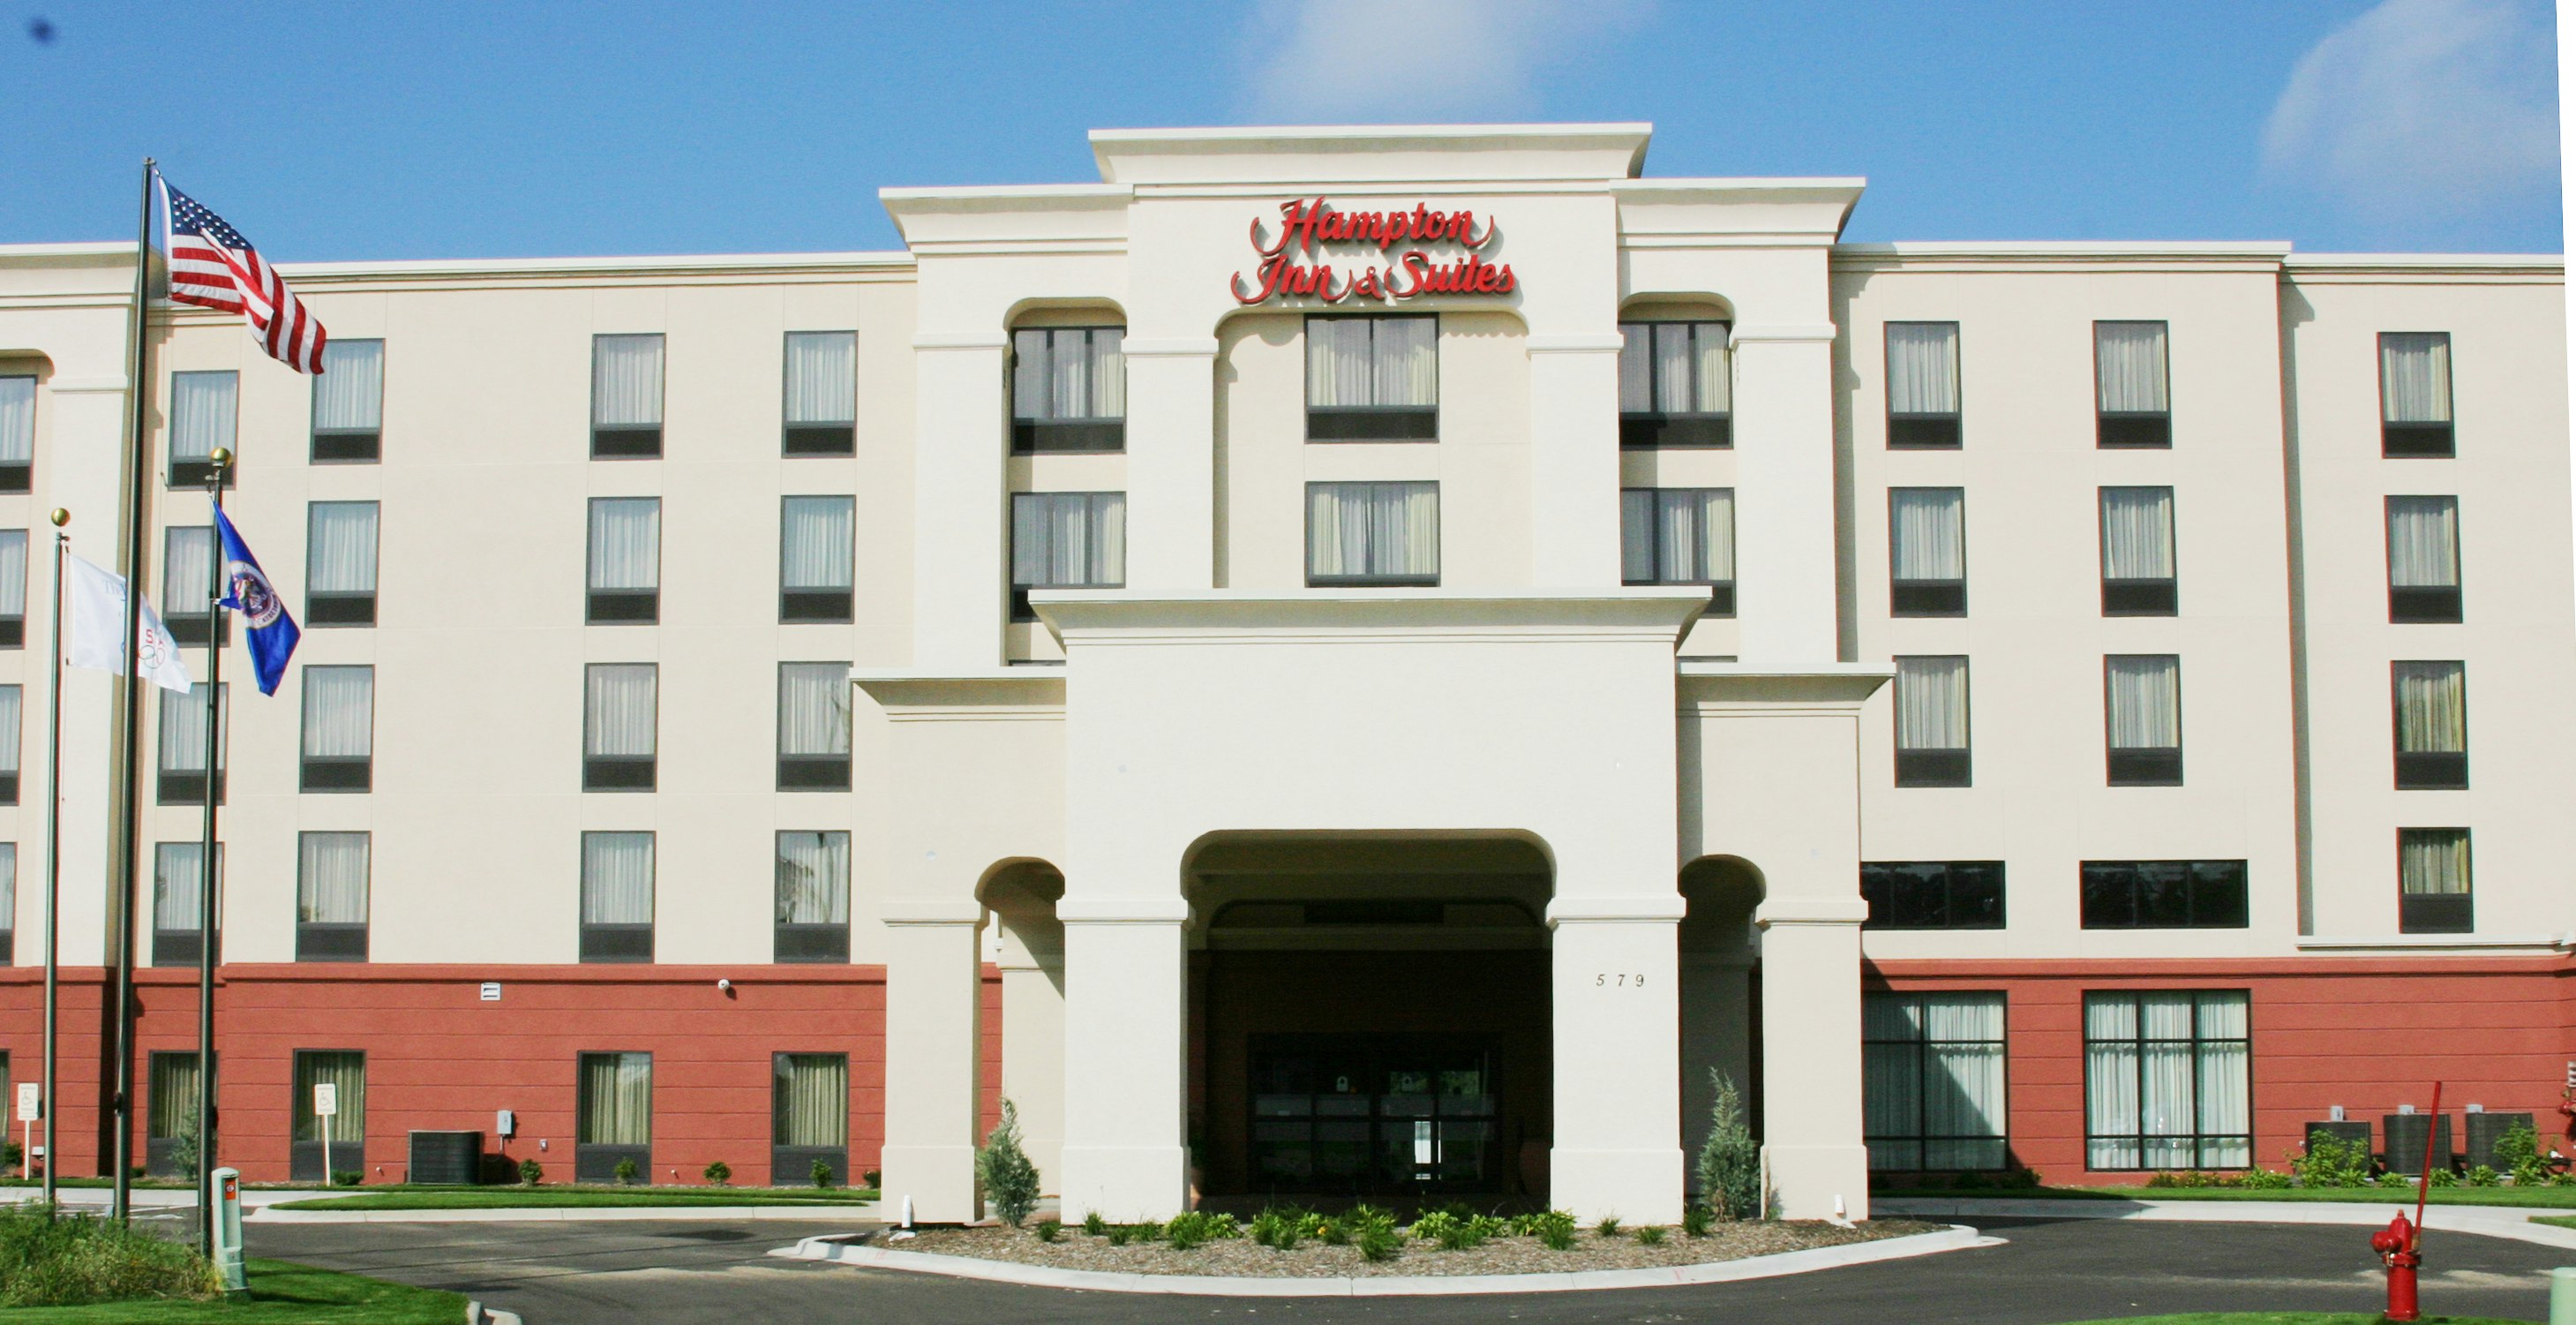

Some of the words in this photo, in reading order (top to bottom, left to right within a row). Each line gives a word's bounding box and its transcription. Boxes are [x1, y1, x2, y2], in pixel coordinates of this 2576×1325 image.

[1250, 195, 1494, 256] Hampton
[1230, 253, 1353, 305] Inn
[1355, 267, 1385, 300] &
[1384, 251, 1515, 298] Suites
